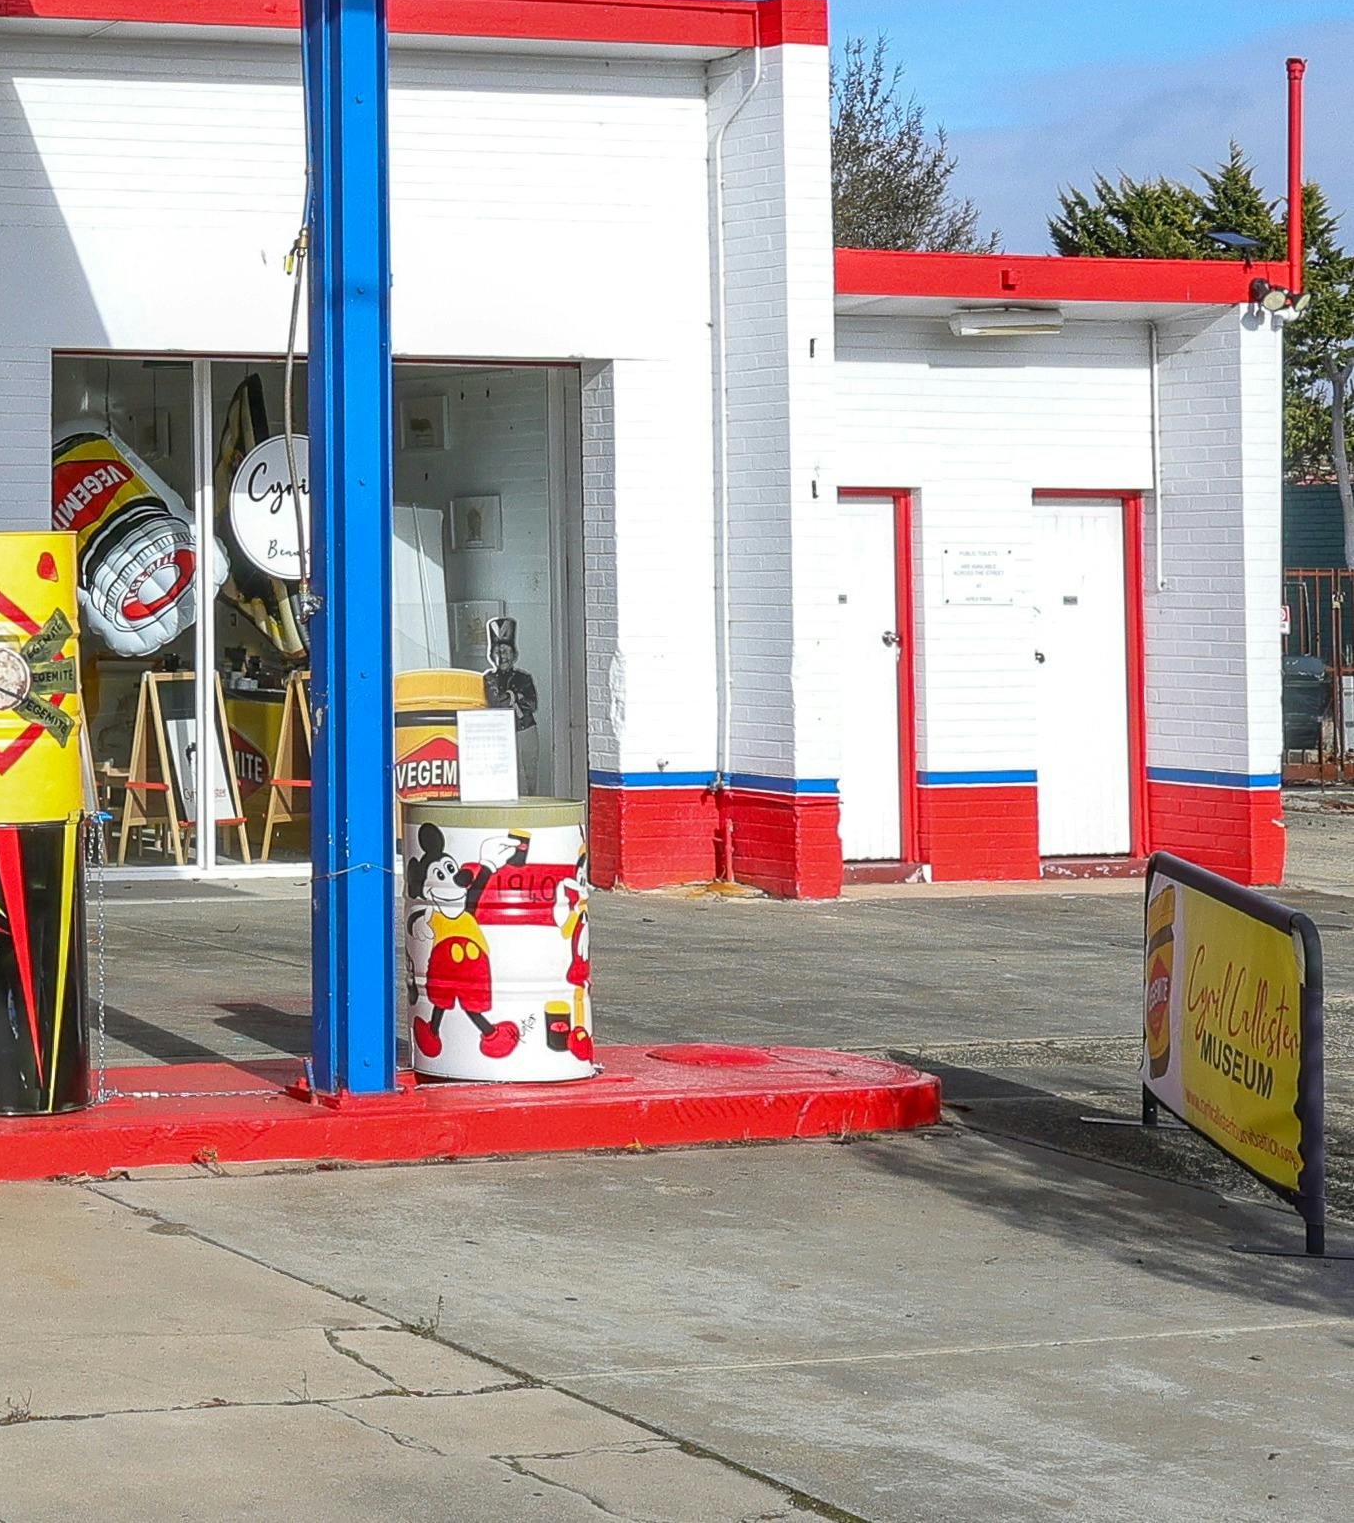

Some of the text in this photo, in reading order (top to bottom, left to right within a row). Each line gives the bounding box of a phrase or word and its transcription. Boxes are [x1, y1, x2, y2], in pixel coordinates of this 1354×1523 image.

[396, 759, 458, 789] VEGEM
[496, 873, 557, 903] 1940
[1188, 944, 1300, 1060] Cyril Callister
[1199, 1029, 1274, 1100] MUSEUM
